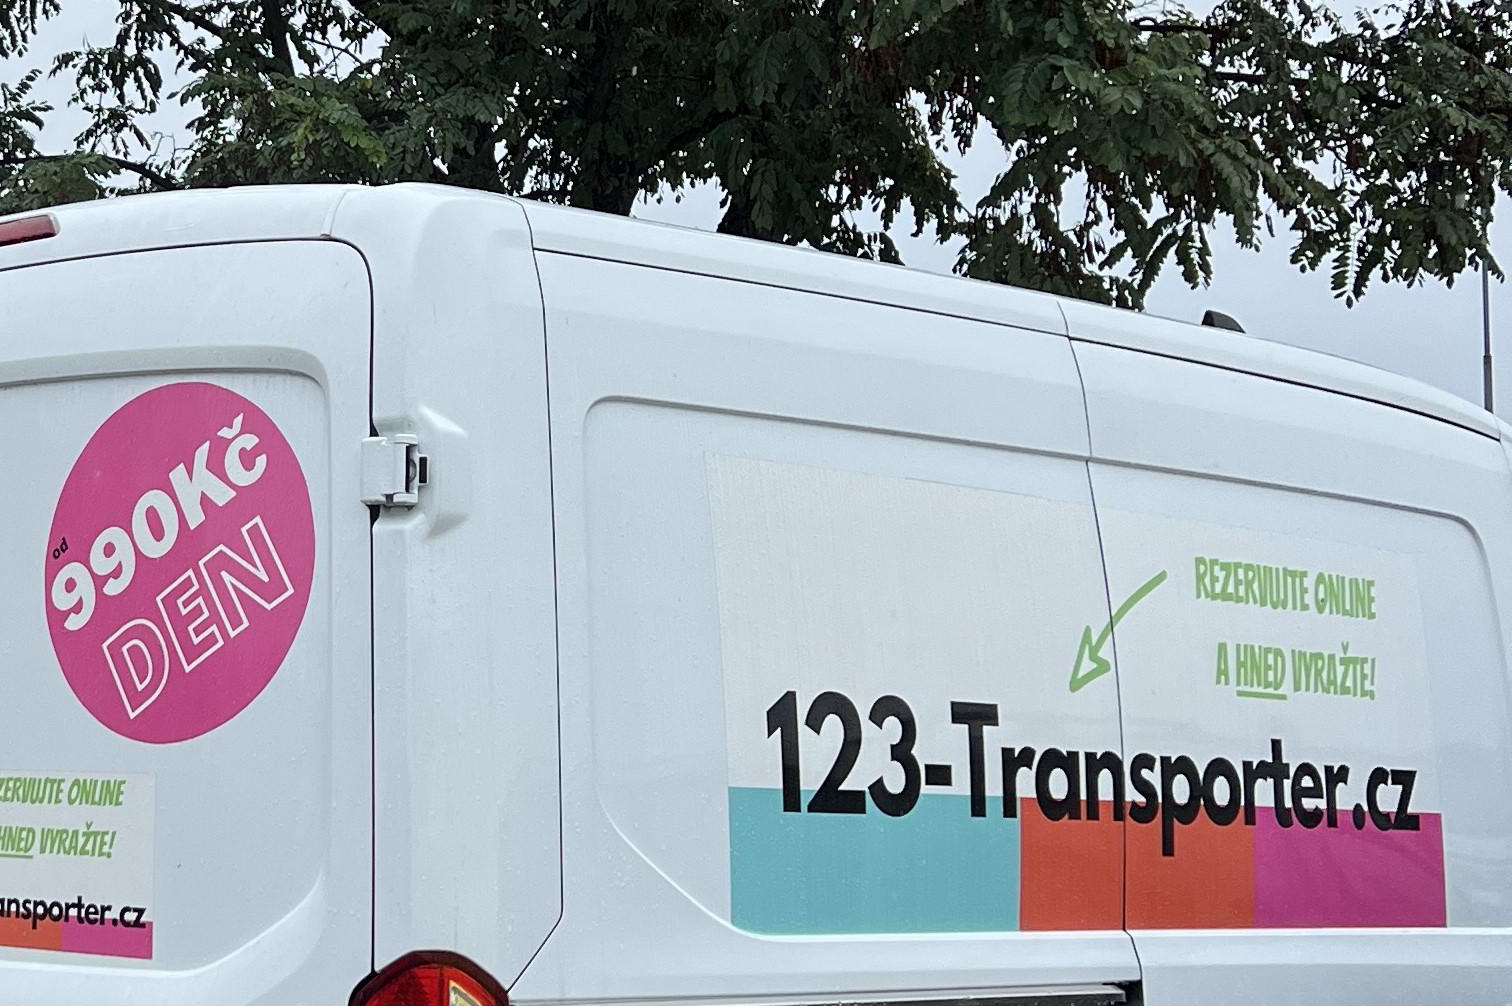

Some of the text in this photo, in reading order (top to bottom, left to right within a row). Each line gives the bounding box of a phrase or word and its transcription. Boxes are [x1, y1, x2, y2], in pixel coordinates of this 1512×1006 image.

[51, 413, 268, 632] 990Kč
[52, 538, 68, 560] od
[102, 515, 295, 720] DEN
[1194, 556, 1377, 620] REZERVUJTE ONLINE
[1215, 641, 1377, 700] A HNED VYRAŽTE!
[67, 779, 127, 806] ONLINE
[766, 690, 1420, 857] 123-Transporter.cz
[39, 821, 117, 858] VYRAŽTE!
